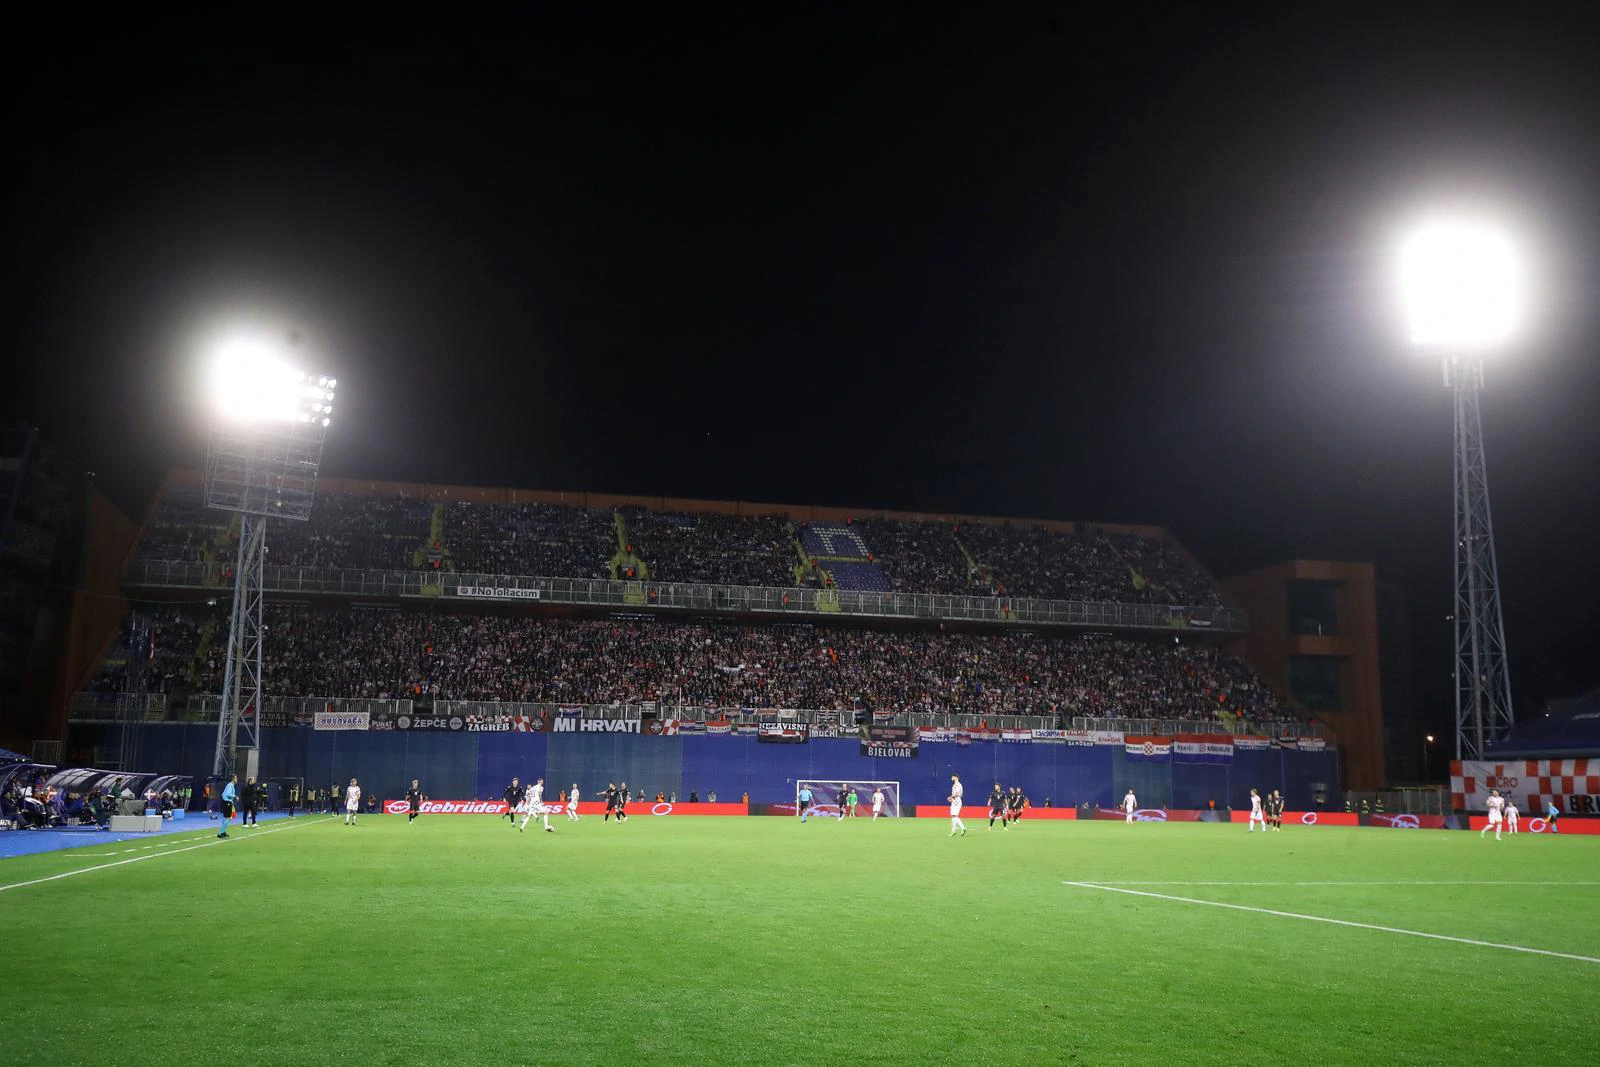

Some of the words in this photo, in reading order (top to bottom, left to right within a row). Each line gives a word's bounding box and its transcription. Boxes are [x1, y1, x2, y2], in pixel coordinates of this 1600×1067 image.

[471, 587, 537, 597] #NoToRacism
[413, 718, 447, 728] ŽEPČE
[467, 723, 510, 732] ZAGREB
[553, 718, 576, 732] MI
[580, 719, 640, 733] HRVATI
[759, 723, 807, 731] NEZAVISNI
[867, 746, 912, 758] BJELOVAR
[1496, 777, 1518, 788] CRO
[419, 801, 506, 814] Gebrüder
[513, 802, 563, 814] Wss
